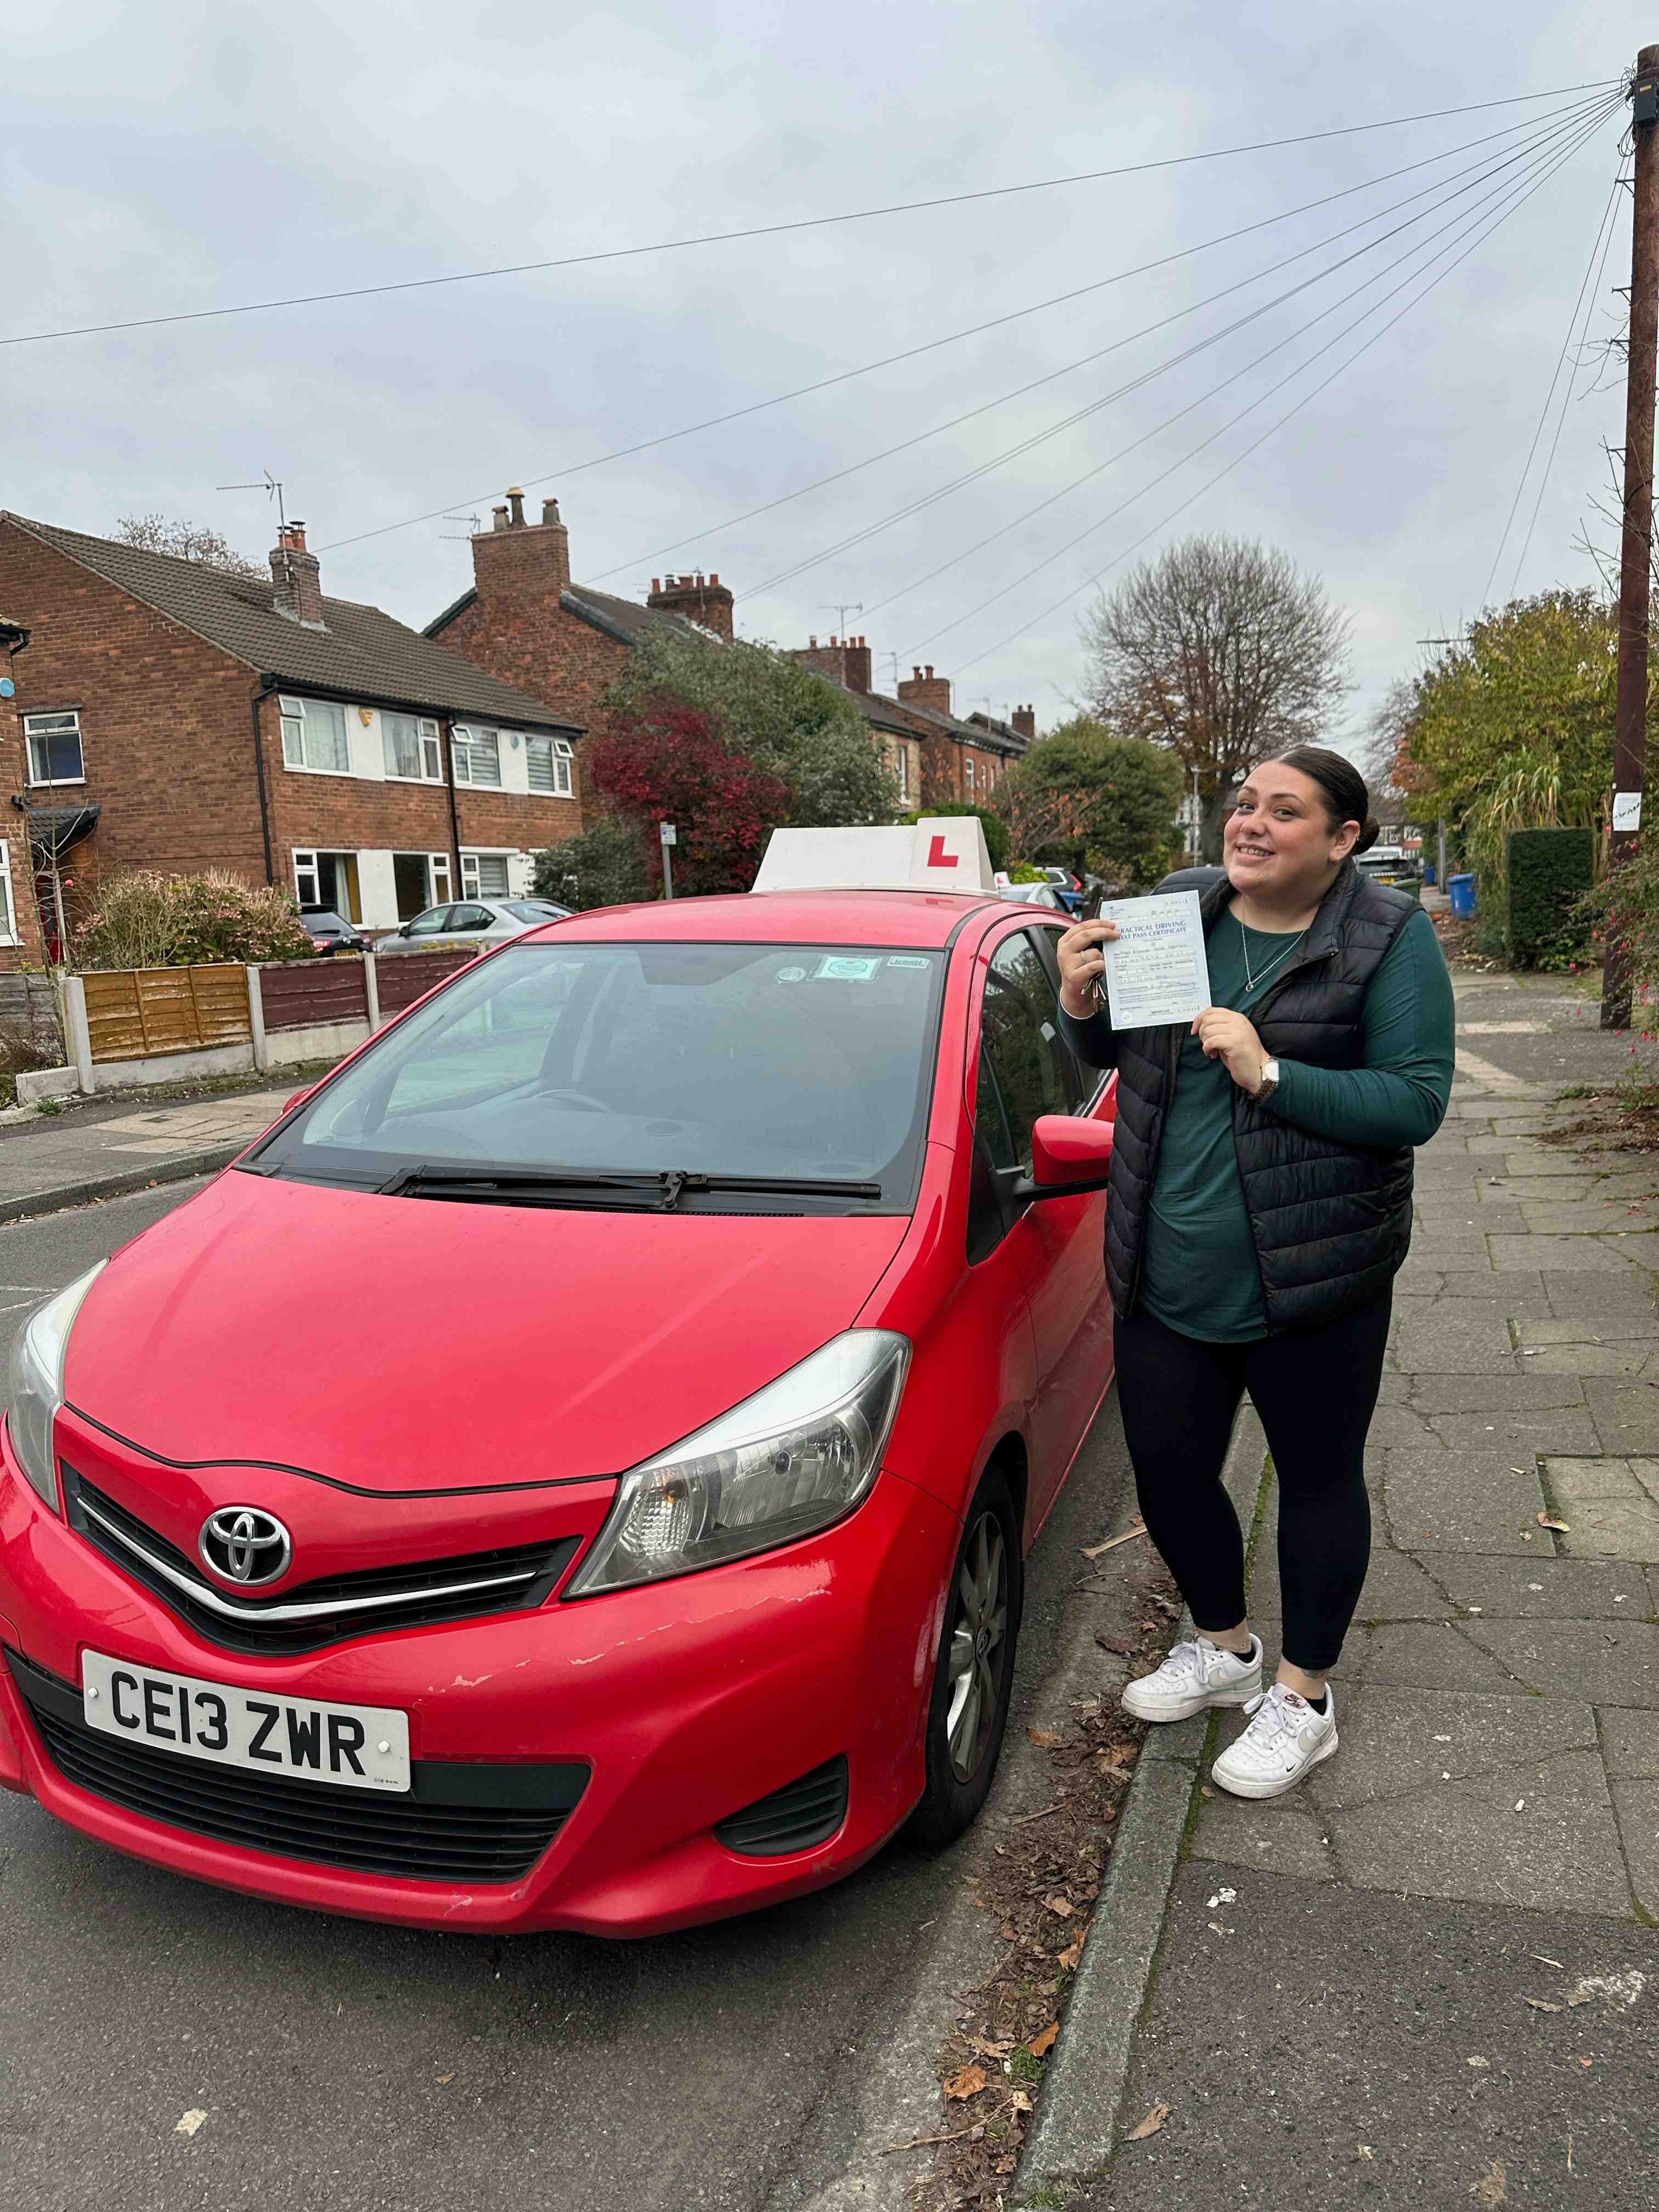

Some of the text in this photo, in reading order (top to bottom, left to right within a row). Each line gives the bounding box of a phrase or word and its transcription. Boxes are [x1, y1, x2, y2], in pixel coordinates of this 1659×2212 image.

[927, 836, 959, 867] L
[1149, 927, 1187, 936] CERTIFICATE
[1155, 921, 1186, 929] DRIVING
[111, 1671, 366, 1776] CE13 ZWR
